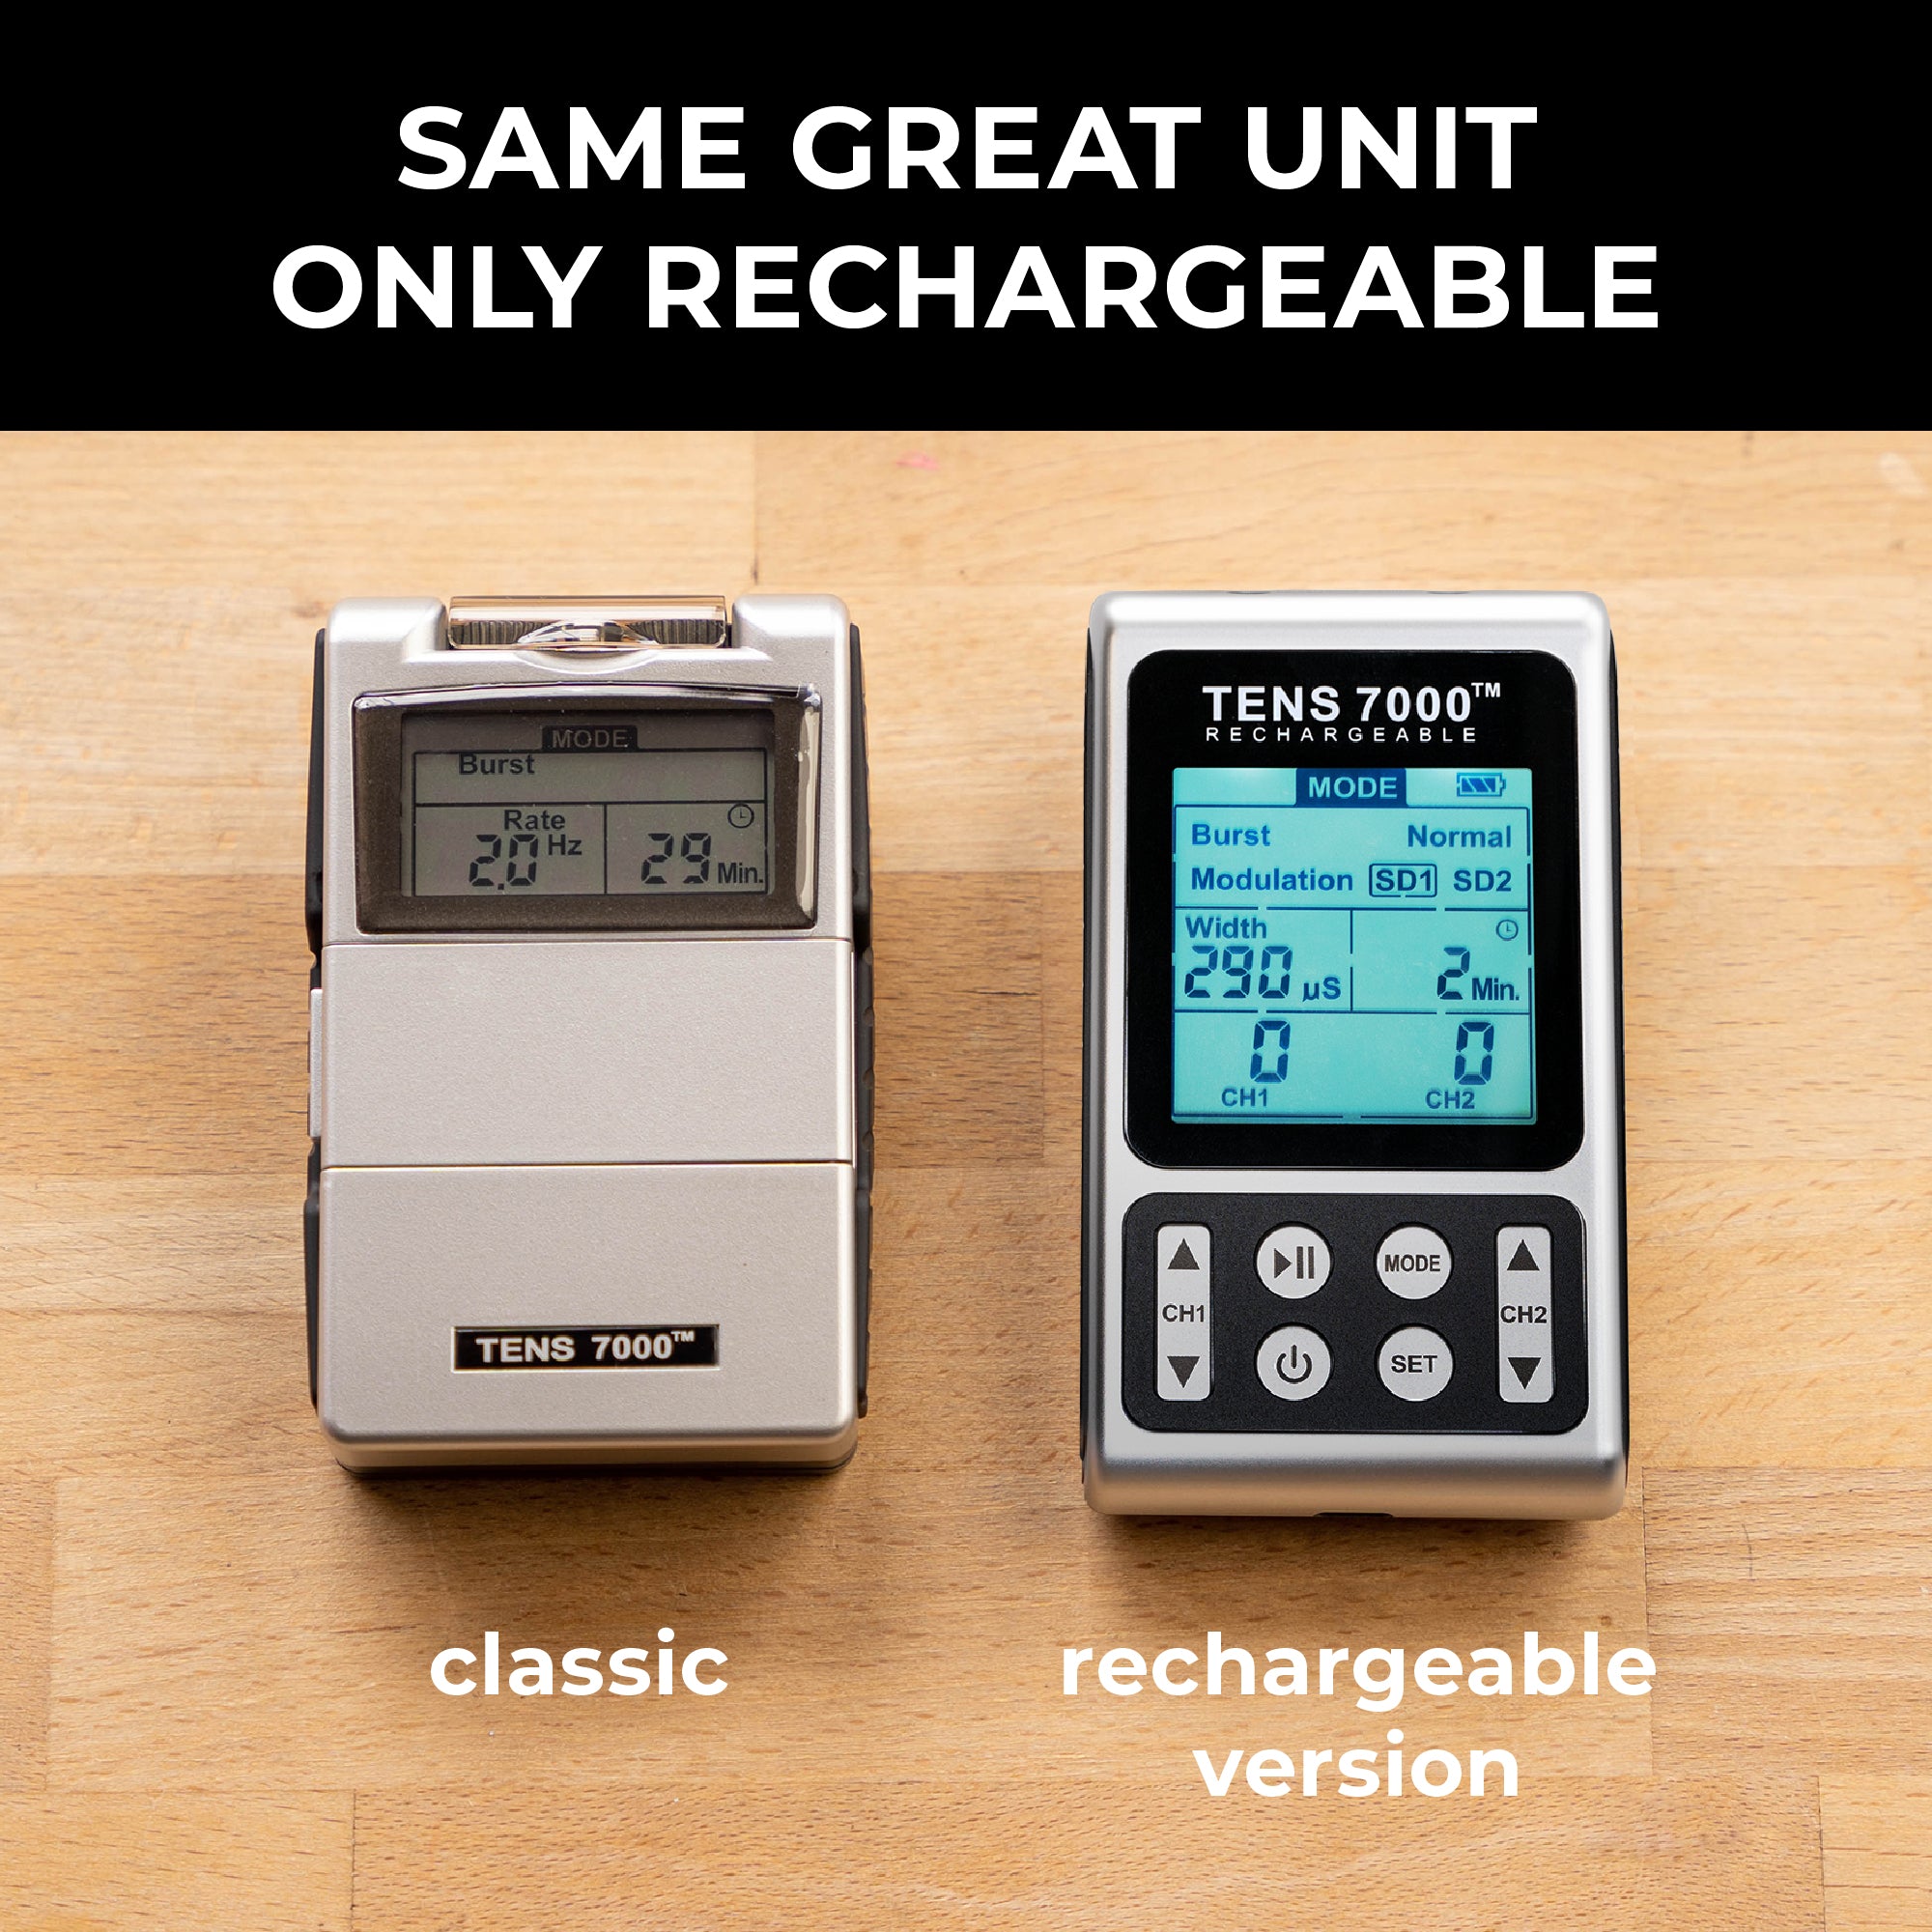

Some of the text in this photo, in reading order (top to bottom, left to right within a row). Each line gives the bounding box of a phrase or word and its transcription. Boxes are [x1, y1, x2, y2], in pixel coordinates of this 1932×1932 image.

[1203, 685, 1341, 723] TENS
[552, 729, 629, 749] MODE
[1206, 726, 1476, 743] RECHARGEABLE
[459, 753, 535, 775] Burst
[1308, 777, 1399, 799] MODE
[503, 810, 566, 831] Rate
[548, 837, 582, 856] Hz
[1192, 824, 1271, 847] Burst
[1408, 825, 1512, 848] Normal
[641, 833, 765, 885] 29 Min.
[1191, 867, 1353, 892] Modulation
[1376, 869, 1432, 893] SD1
[1453, 869, 1512, 893] SD2
[1185, 917, 1267, 940] Width
[1184, 946, 1293, 999] 290
[1437, 947, 1520, 1002] 2 Min.
[1250, 1020, 1291, 1083] 0
[1454, 1021, 1494, 1086] 0
[1221, 1089, 1268, 1107] CH1
[1426, 1091, 1476, 1110] CH2
[1384, 1254, 1441, 1272] MODE
[1161, 1304, 1206, 1323] CH1
[1499, 1305, 1548, 1324] CH2
[476, 1336, 576, 1363] TENS
[1391, 1354, 1437, 1374] SET
